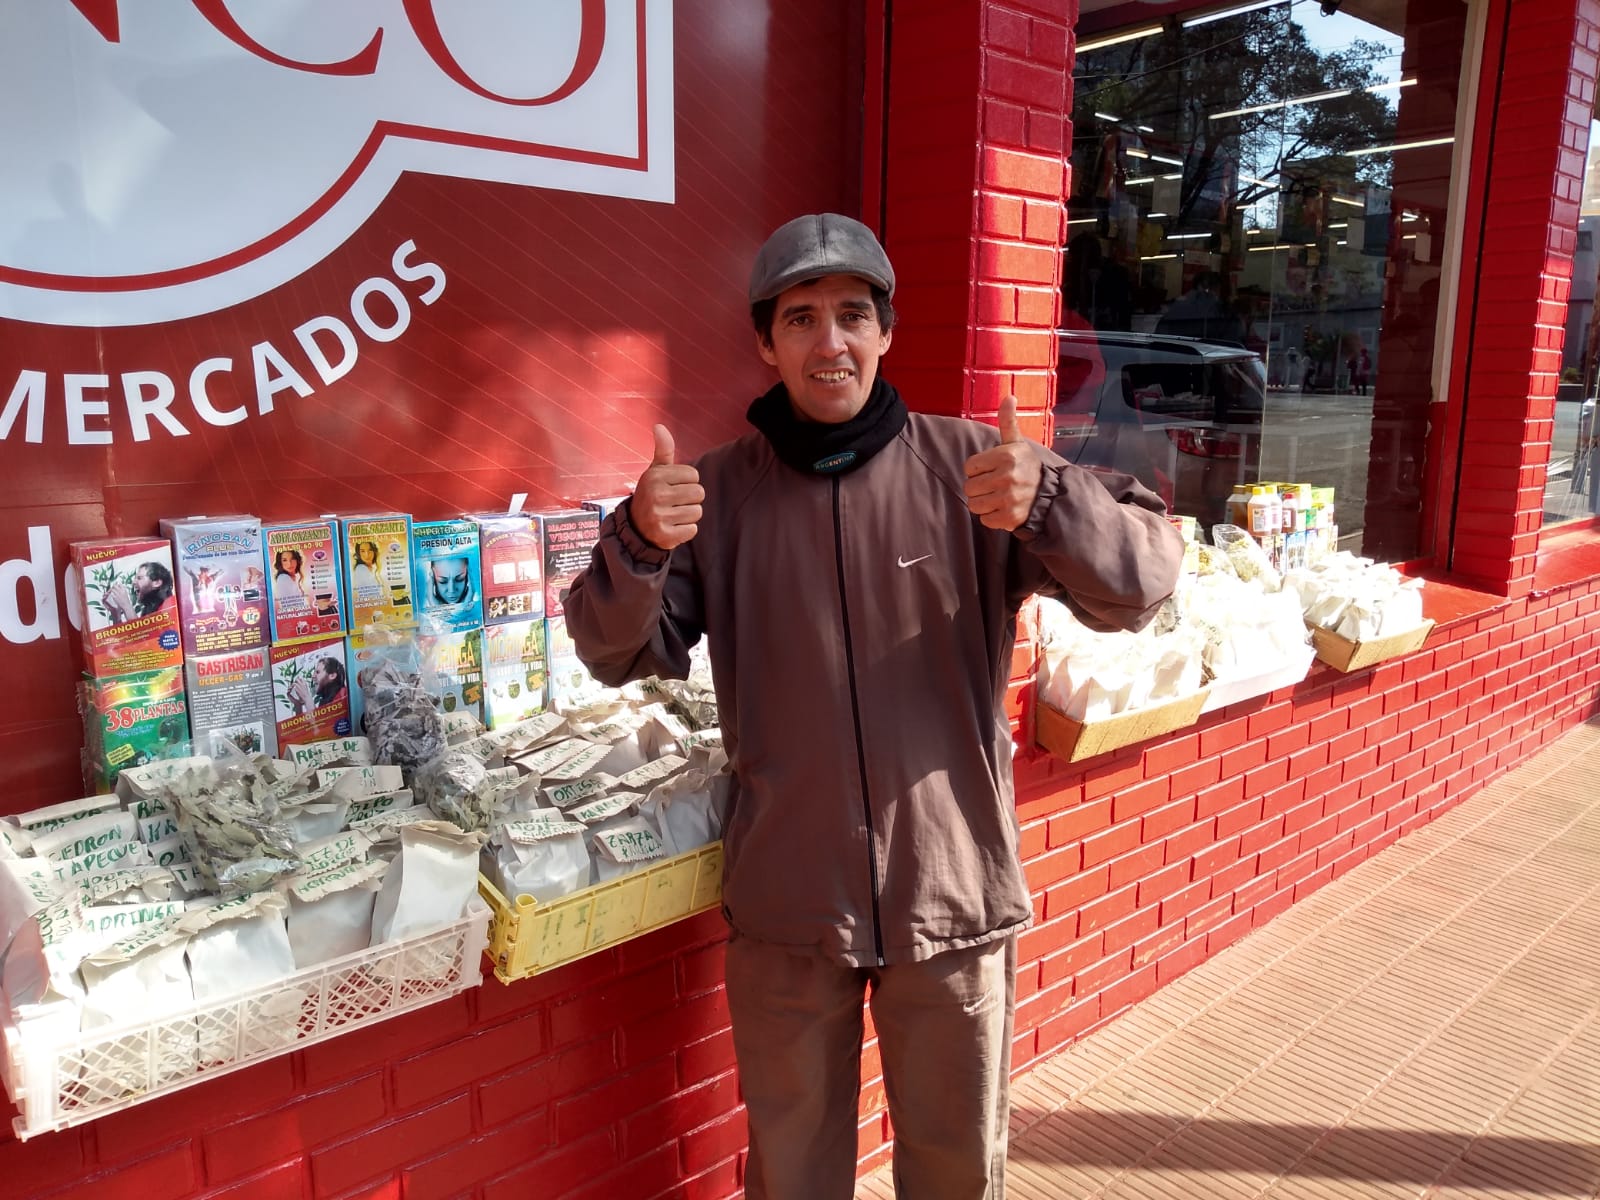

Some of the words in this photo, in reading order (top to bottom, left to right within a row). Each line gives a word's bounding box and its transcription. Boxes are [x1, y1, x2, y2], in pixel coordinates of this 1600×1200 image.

[421, 538, 453, 548] PRESION
[455, 536, 472, 545] ALTA
[86, 549, 118, 562] NUEVO!
[95, 612, 170, 640] BRONQUIOTOS
[196, 652, 264, 677] GASTRISAN
[273, 647, 300, 660] NUEVO!
[105, 706, 134, 732] 38
[133, 701, 185, 721] PLANTAS
[281, 702, 343, 730] BRONQUIOTOS
